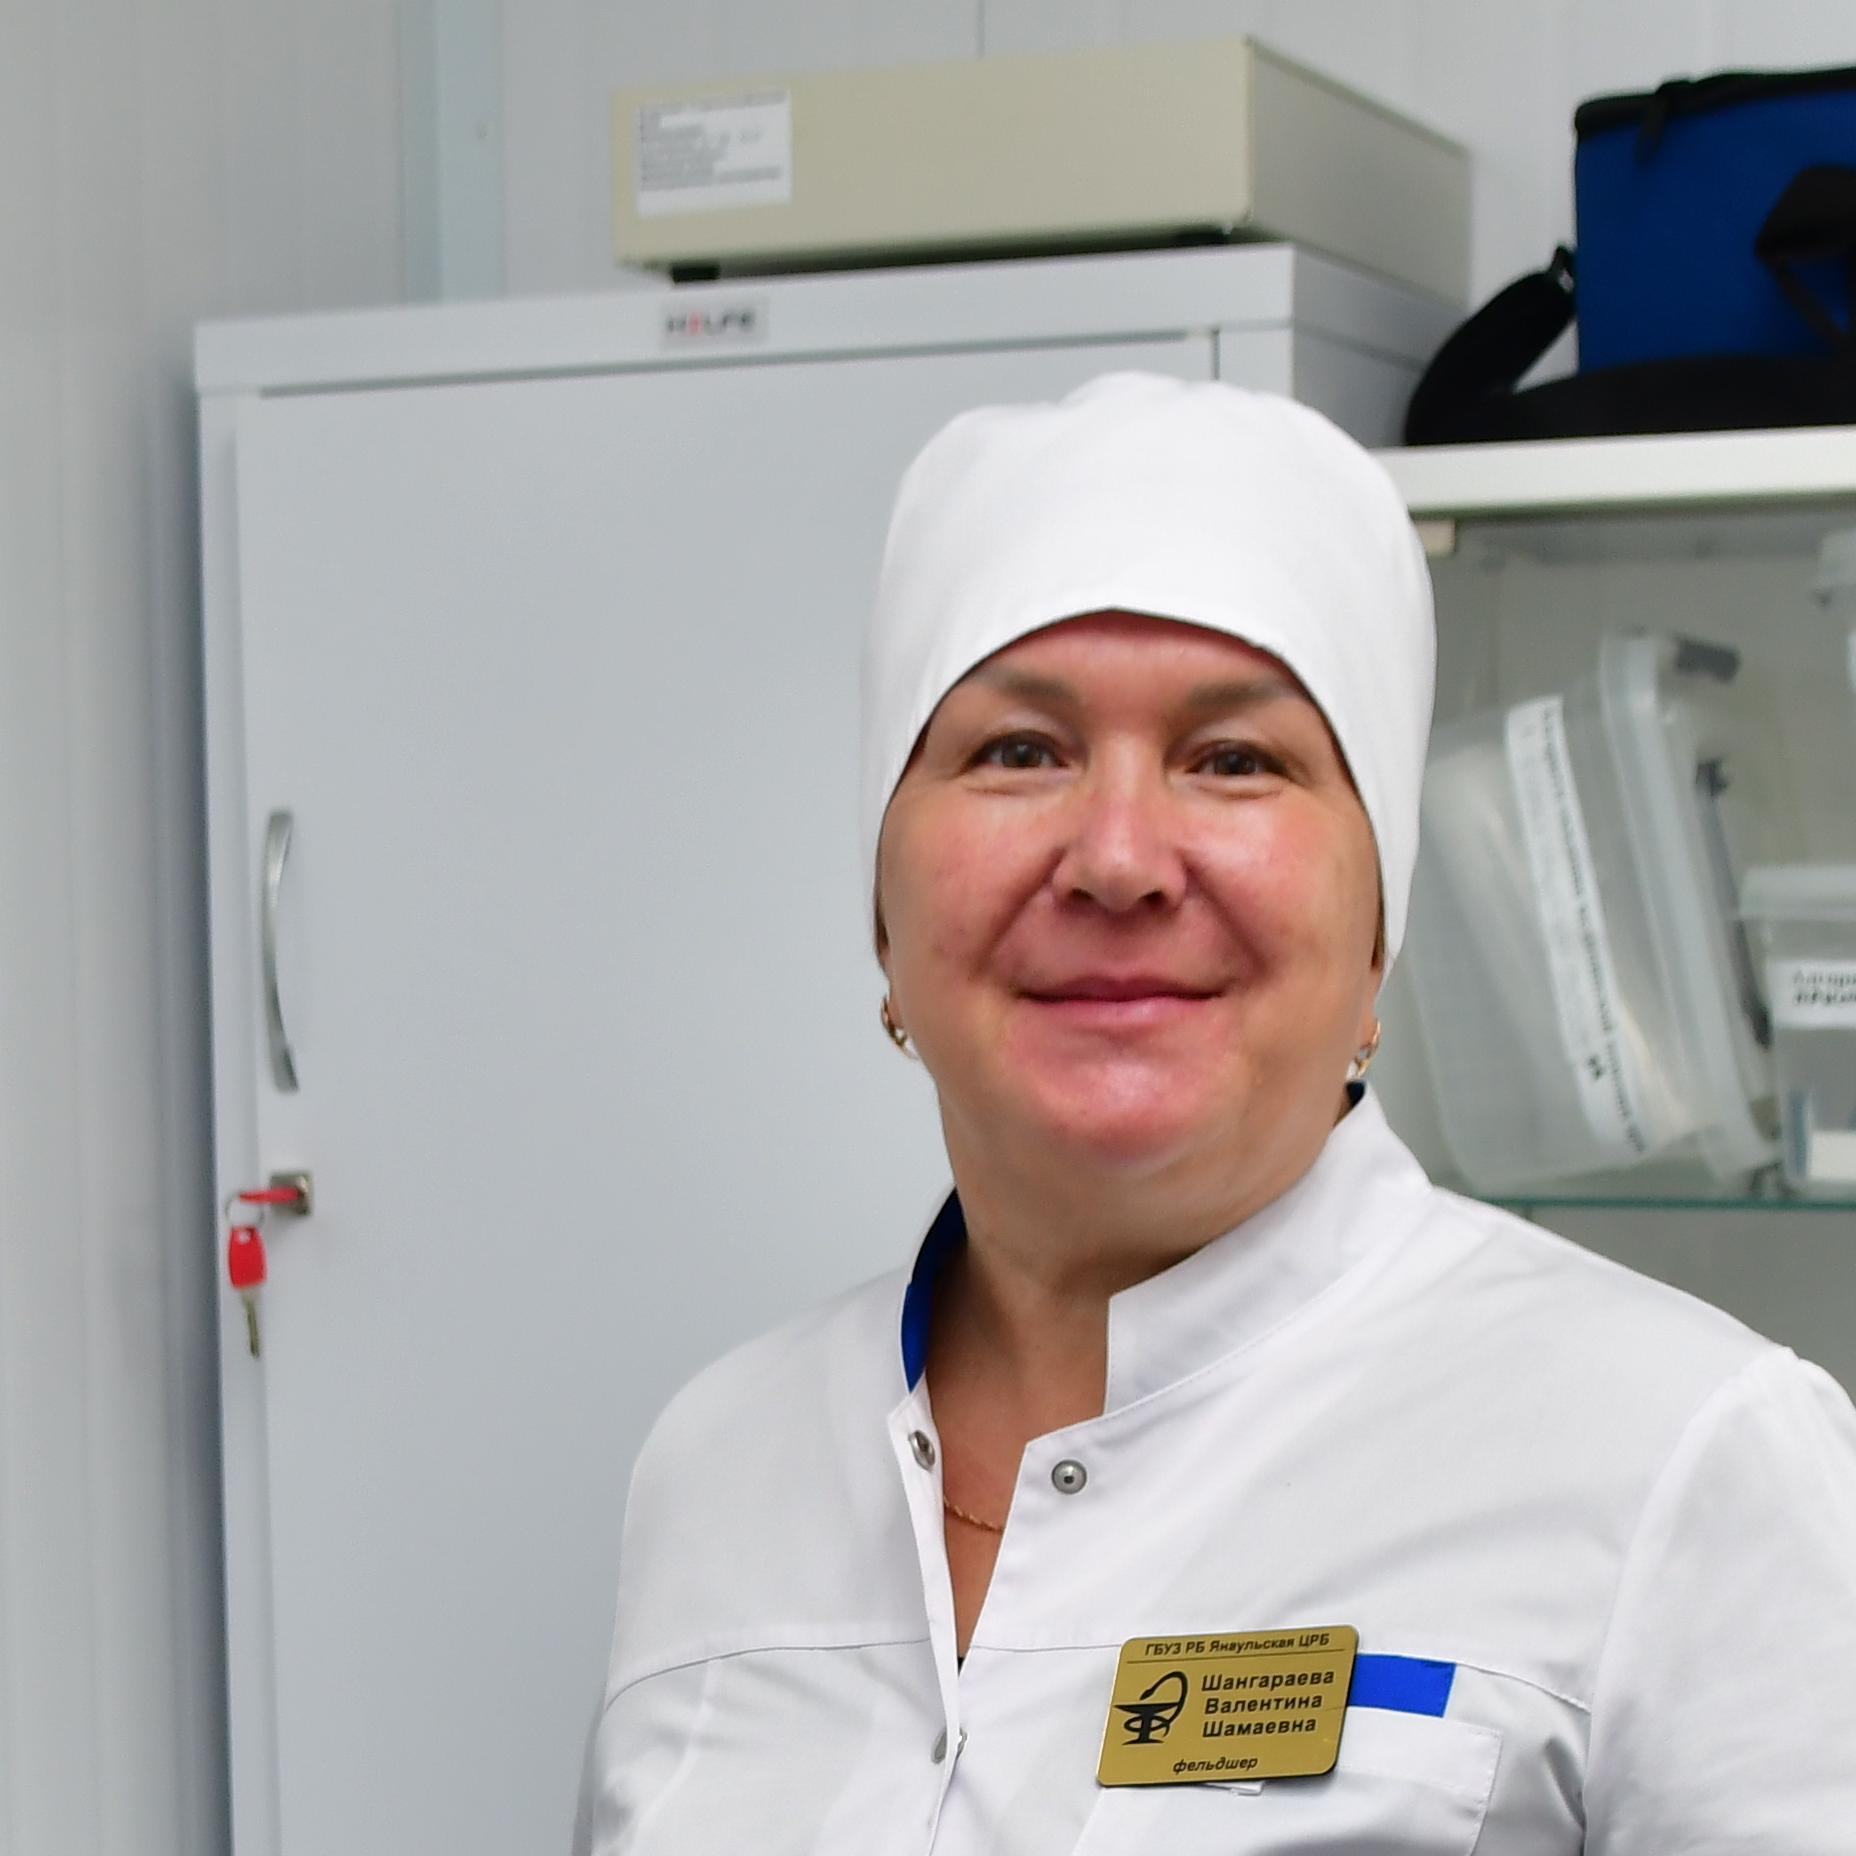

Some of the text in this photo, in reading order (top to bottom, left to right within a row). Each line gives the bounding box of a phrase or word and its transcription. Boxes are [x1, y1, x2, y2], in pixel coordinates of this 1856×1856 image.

[1144, 1633, 1330, 1657] ГБУЗ РБ Янаульская ЦРБ
[1200, 1669, 1335, 1693] Шангараева
[1204, 1693, 1323, 1715] Валентина
[1202, 1717, 1317, 1739] Шамаевна
[1172, 1755, 1259, 1775] фельдшер
